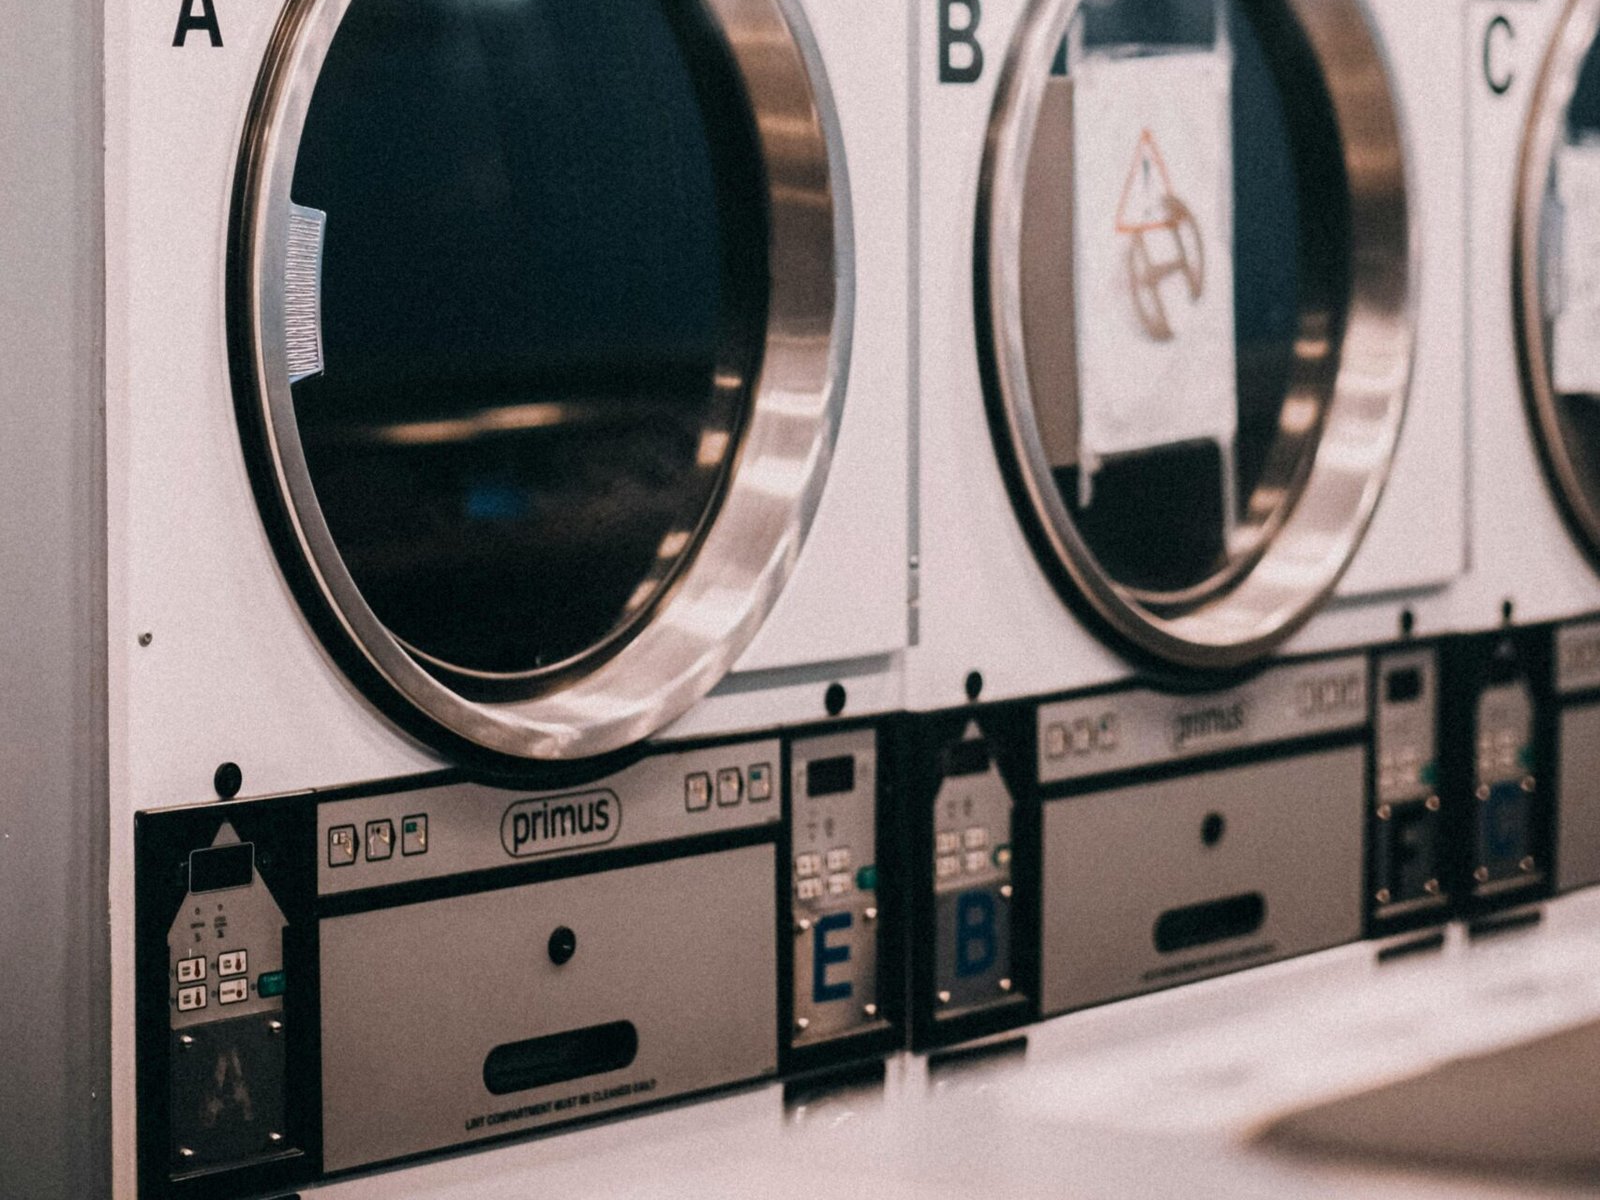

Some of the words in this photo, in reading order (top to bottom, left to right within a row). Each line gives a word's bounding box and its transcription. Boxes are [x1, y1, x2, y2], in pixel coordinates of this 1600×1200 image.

[1484, 16, 1514, 94] C
[512, 798, 610, 853] primus
[813, 912, 854, 1003] E
[956, 890, 996, 978] B
